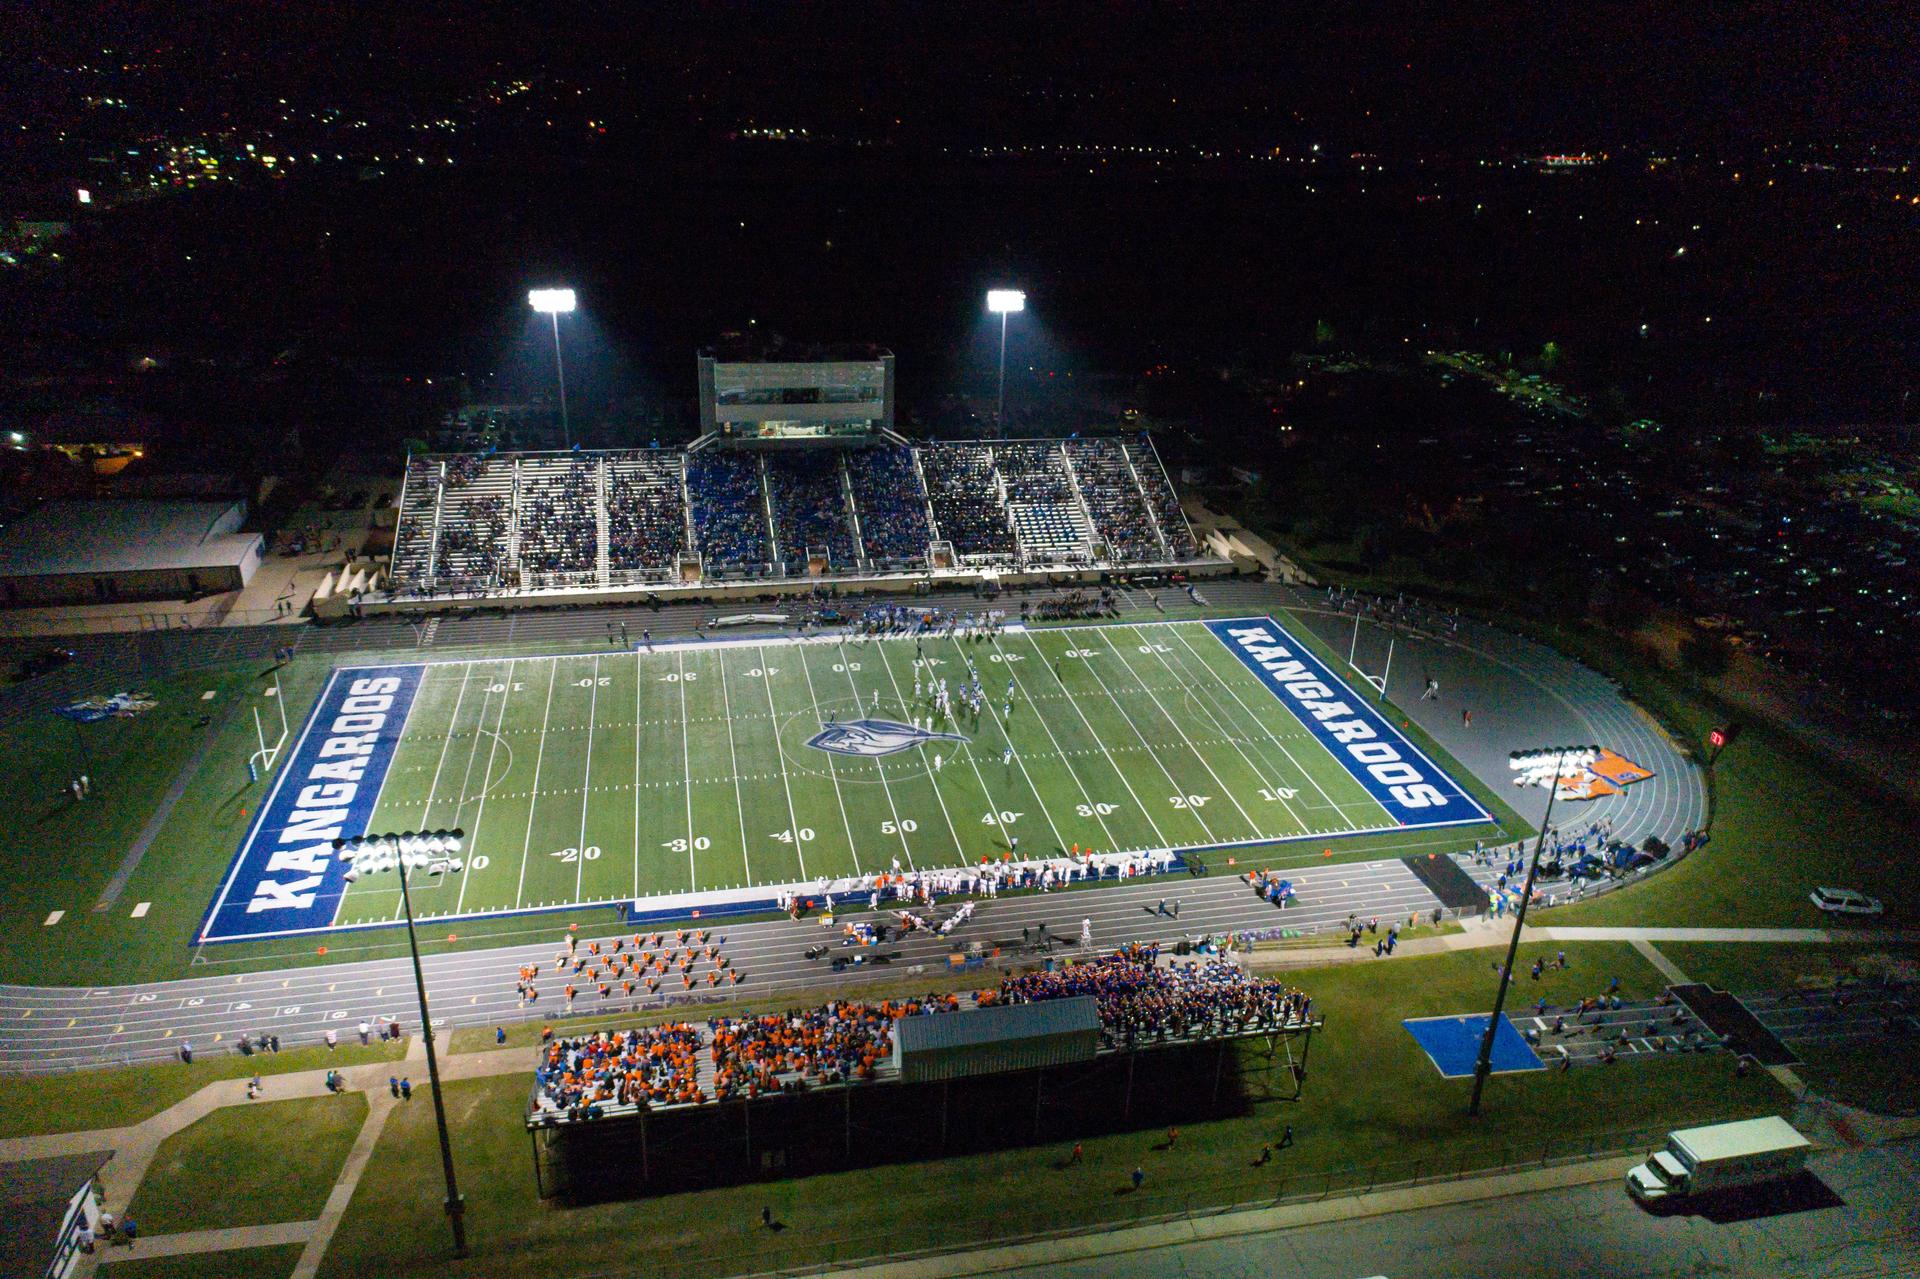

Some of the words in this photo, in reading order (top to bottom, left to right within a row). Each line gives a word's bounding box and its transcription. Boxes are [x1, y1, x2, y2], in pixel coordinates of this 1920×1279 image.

[990, 653, 1019, 663] 30
[1065, 648, 1093, 658] 20
[749, 667, 780, 677] 40
[832, 662, 861, 672] 50
[579, 677, 612, 687] 20
[666, 672, 697, 682] 30
[491, 682, 524, 692] 10
[1228, 627, 1448, 808] KANGAROOS
[246, 677, 401, 913] KANGAROOS
[1257, 787, 1294, 801] 10
[1169, 794, 1206, 809] 20
[1075, 802, 1112, 817] 30
[981, 811, 1016, 825] 40
[881, 819, 918, 834] 50
[778, 828, 815, 843] 40
[672, 836, 711, 852] 30
[560, 846, 601, 862] 20
